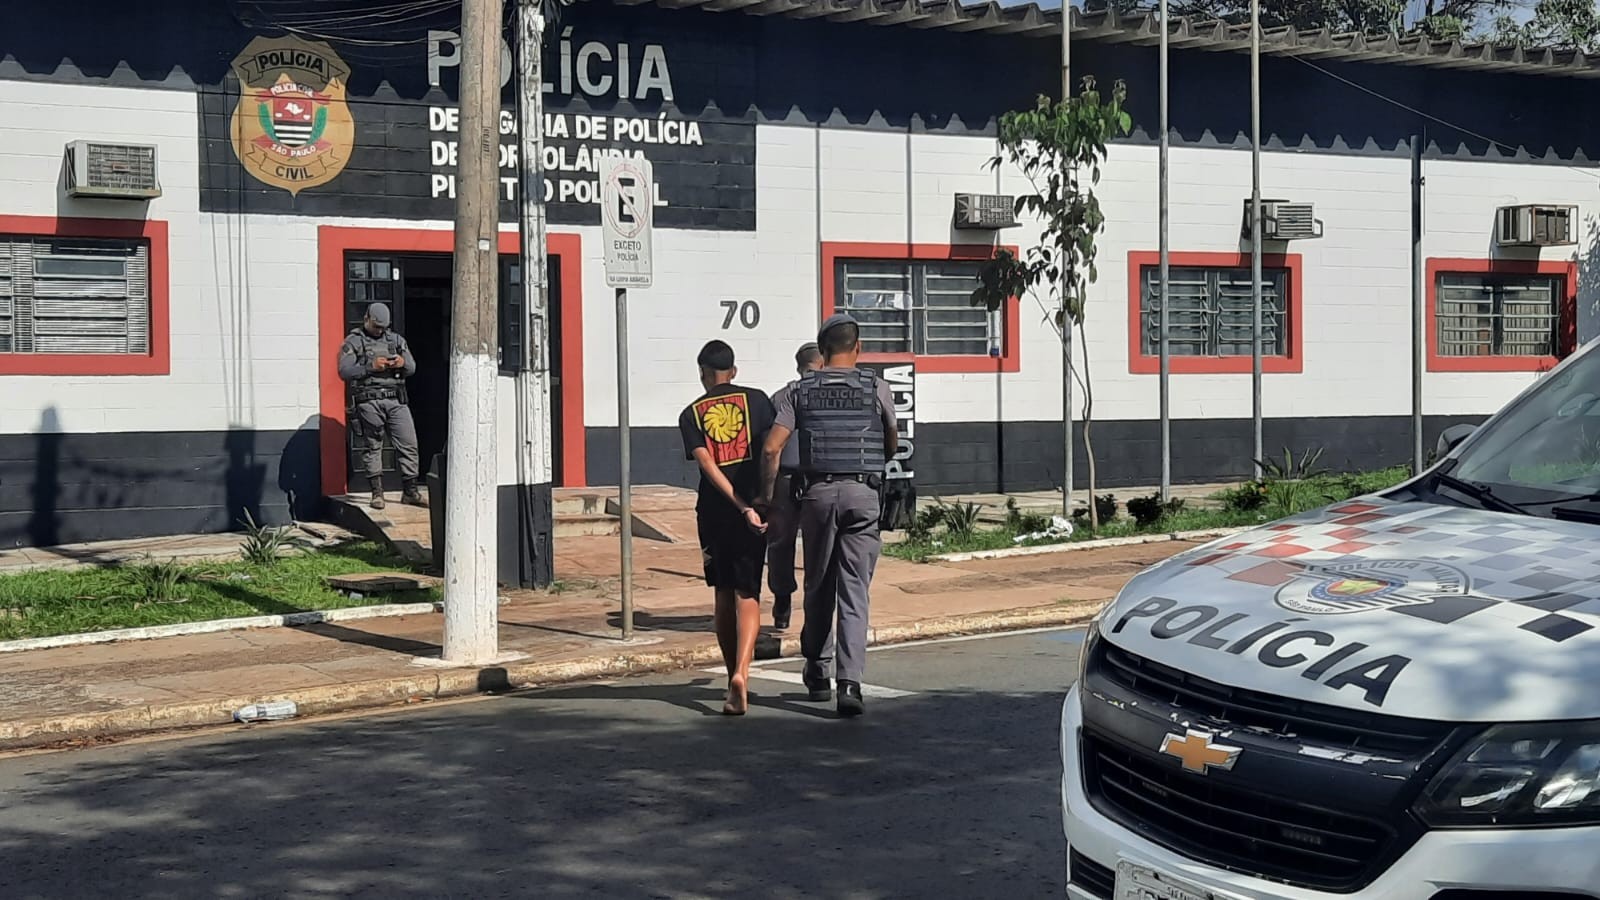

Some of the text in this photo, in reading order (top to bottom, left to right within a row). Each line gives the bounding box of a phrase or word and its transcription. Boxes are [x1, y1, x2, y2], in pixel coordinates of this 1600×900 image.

[428, 26, 674, 101] PÍCIA
[429, 106, 703, 146] DEGIA DE POLÍCIA
[290, 145, 316, 157] PAULO
[499, 143, 646, 173] OROLÂN
[275, 166, 313, 180] CIVIL
[559, 179, 668, 206] POLL
[614, 240, 641, 251] EXCETO
[720, 300, 761, 330] 70
[811, 399, 862, 409] MILITAR
[1111, 596, 1412, 708] POLÍCIA
